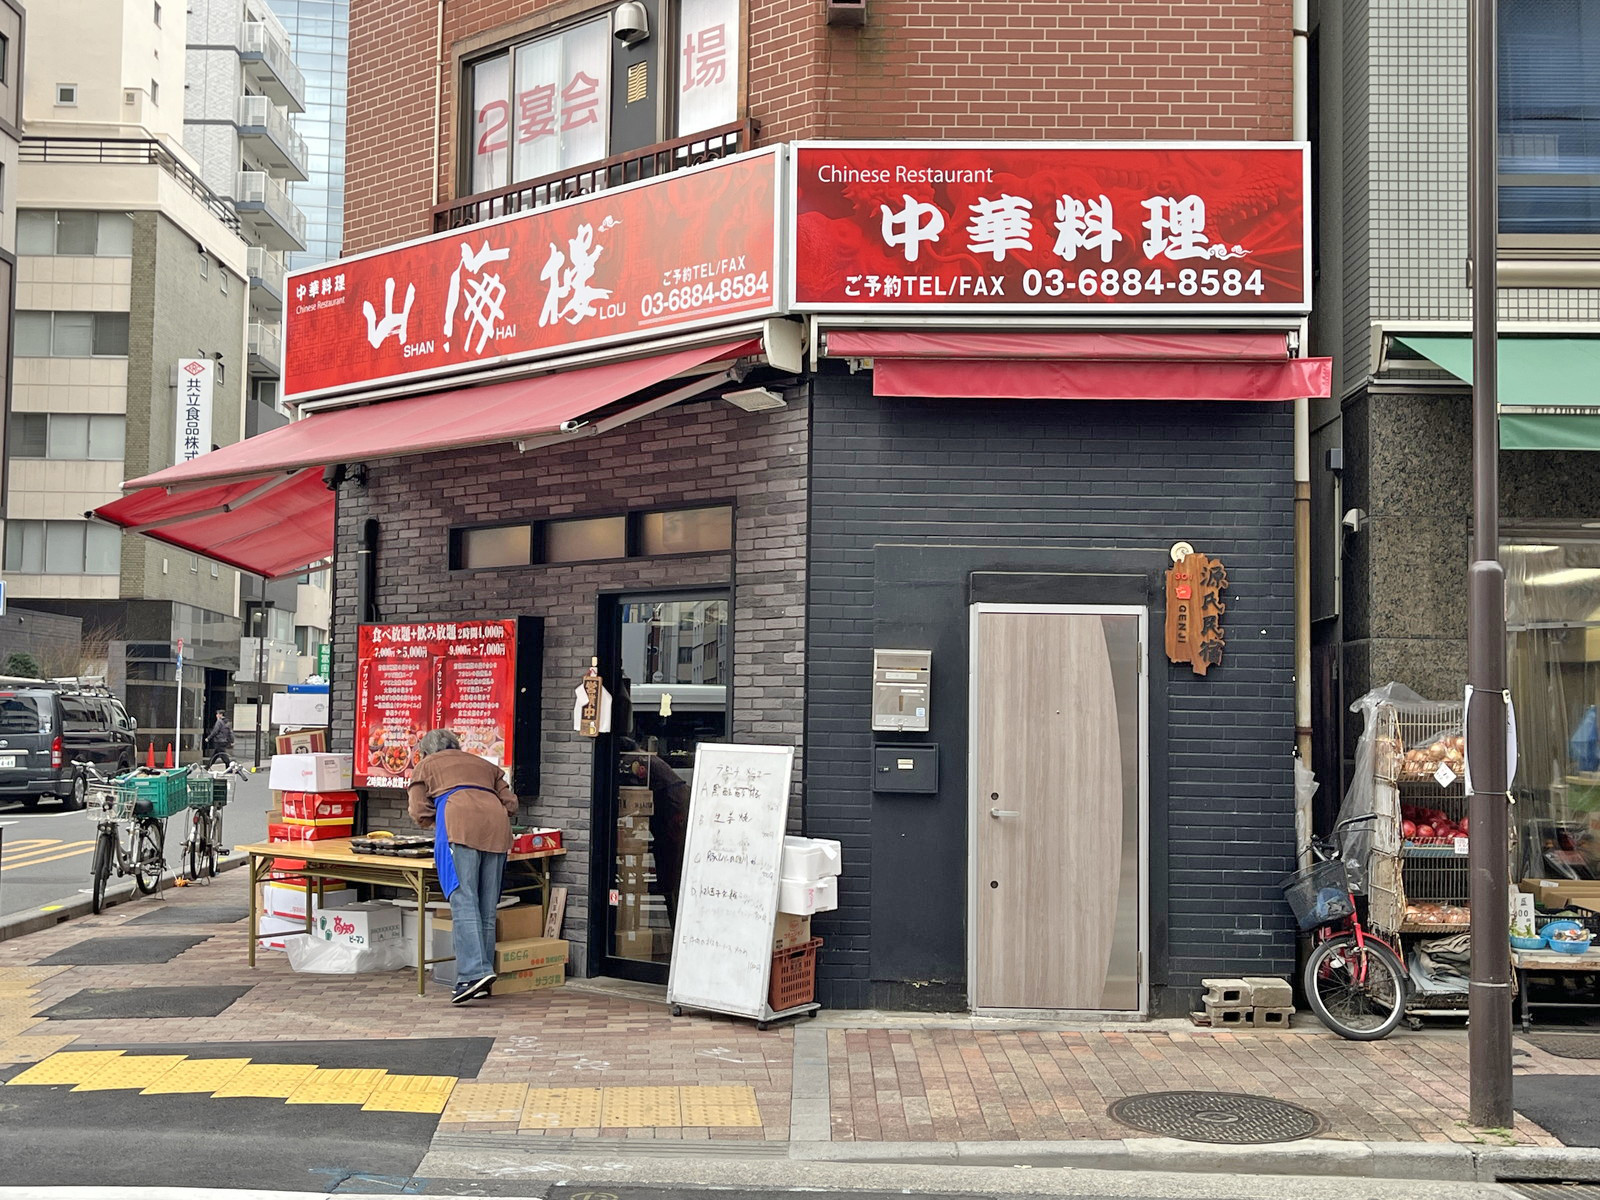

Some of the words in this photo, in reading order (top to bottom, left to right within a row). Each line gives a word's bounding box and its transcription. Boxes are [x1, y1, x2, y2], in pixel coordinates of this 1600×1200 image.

[817, 165, 891, 184] Chinese
[895, 165, 994, 184] Restaurant
[880, 193, 1211, 263] 中華料理
[296, 273, 346, 302] 中華料理
[1022, 268, 1265, 297] 03-6884-8584
[640, 271, 769, 317] 03-6884-8584
[295, 300, 316, 315] Chinese
[316, 295, 346, 310] Restaurant
[599, 302, 626, 320] LOU
[495, 324, 517, 341] HAI
[403, 340, 435, 358] SHAN
[1178, 605, 1187, 644] GENJI
[349, 935, 365, 944] ピーマン
